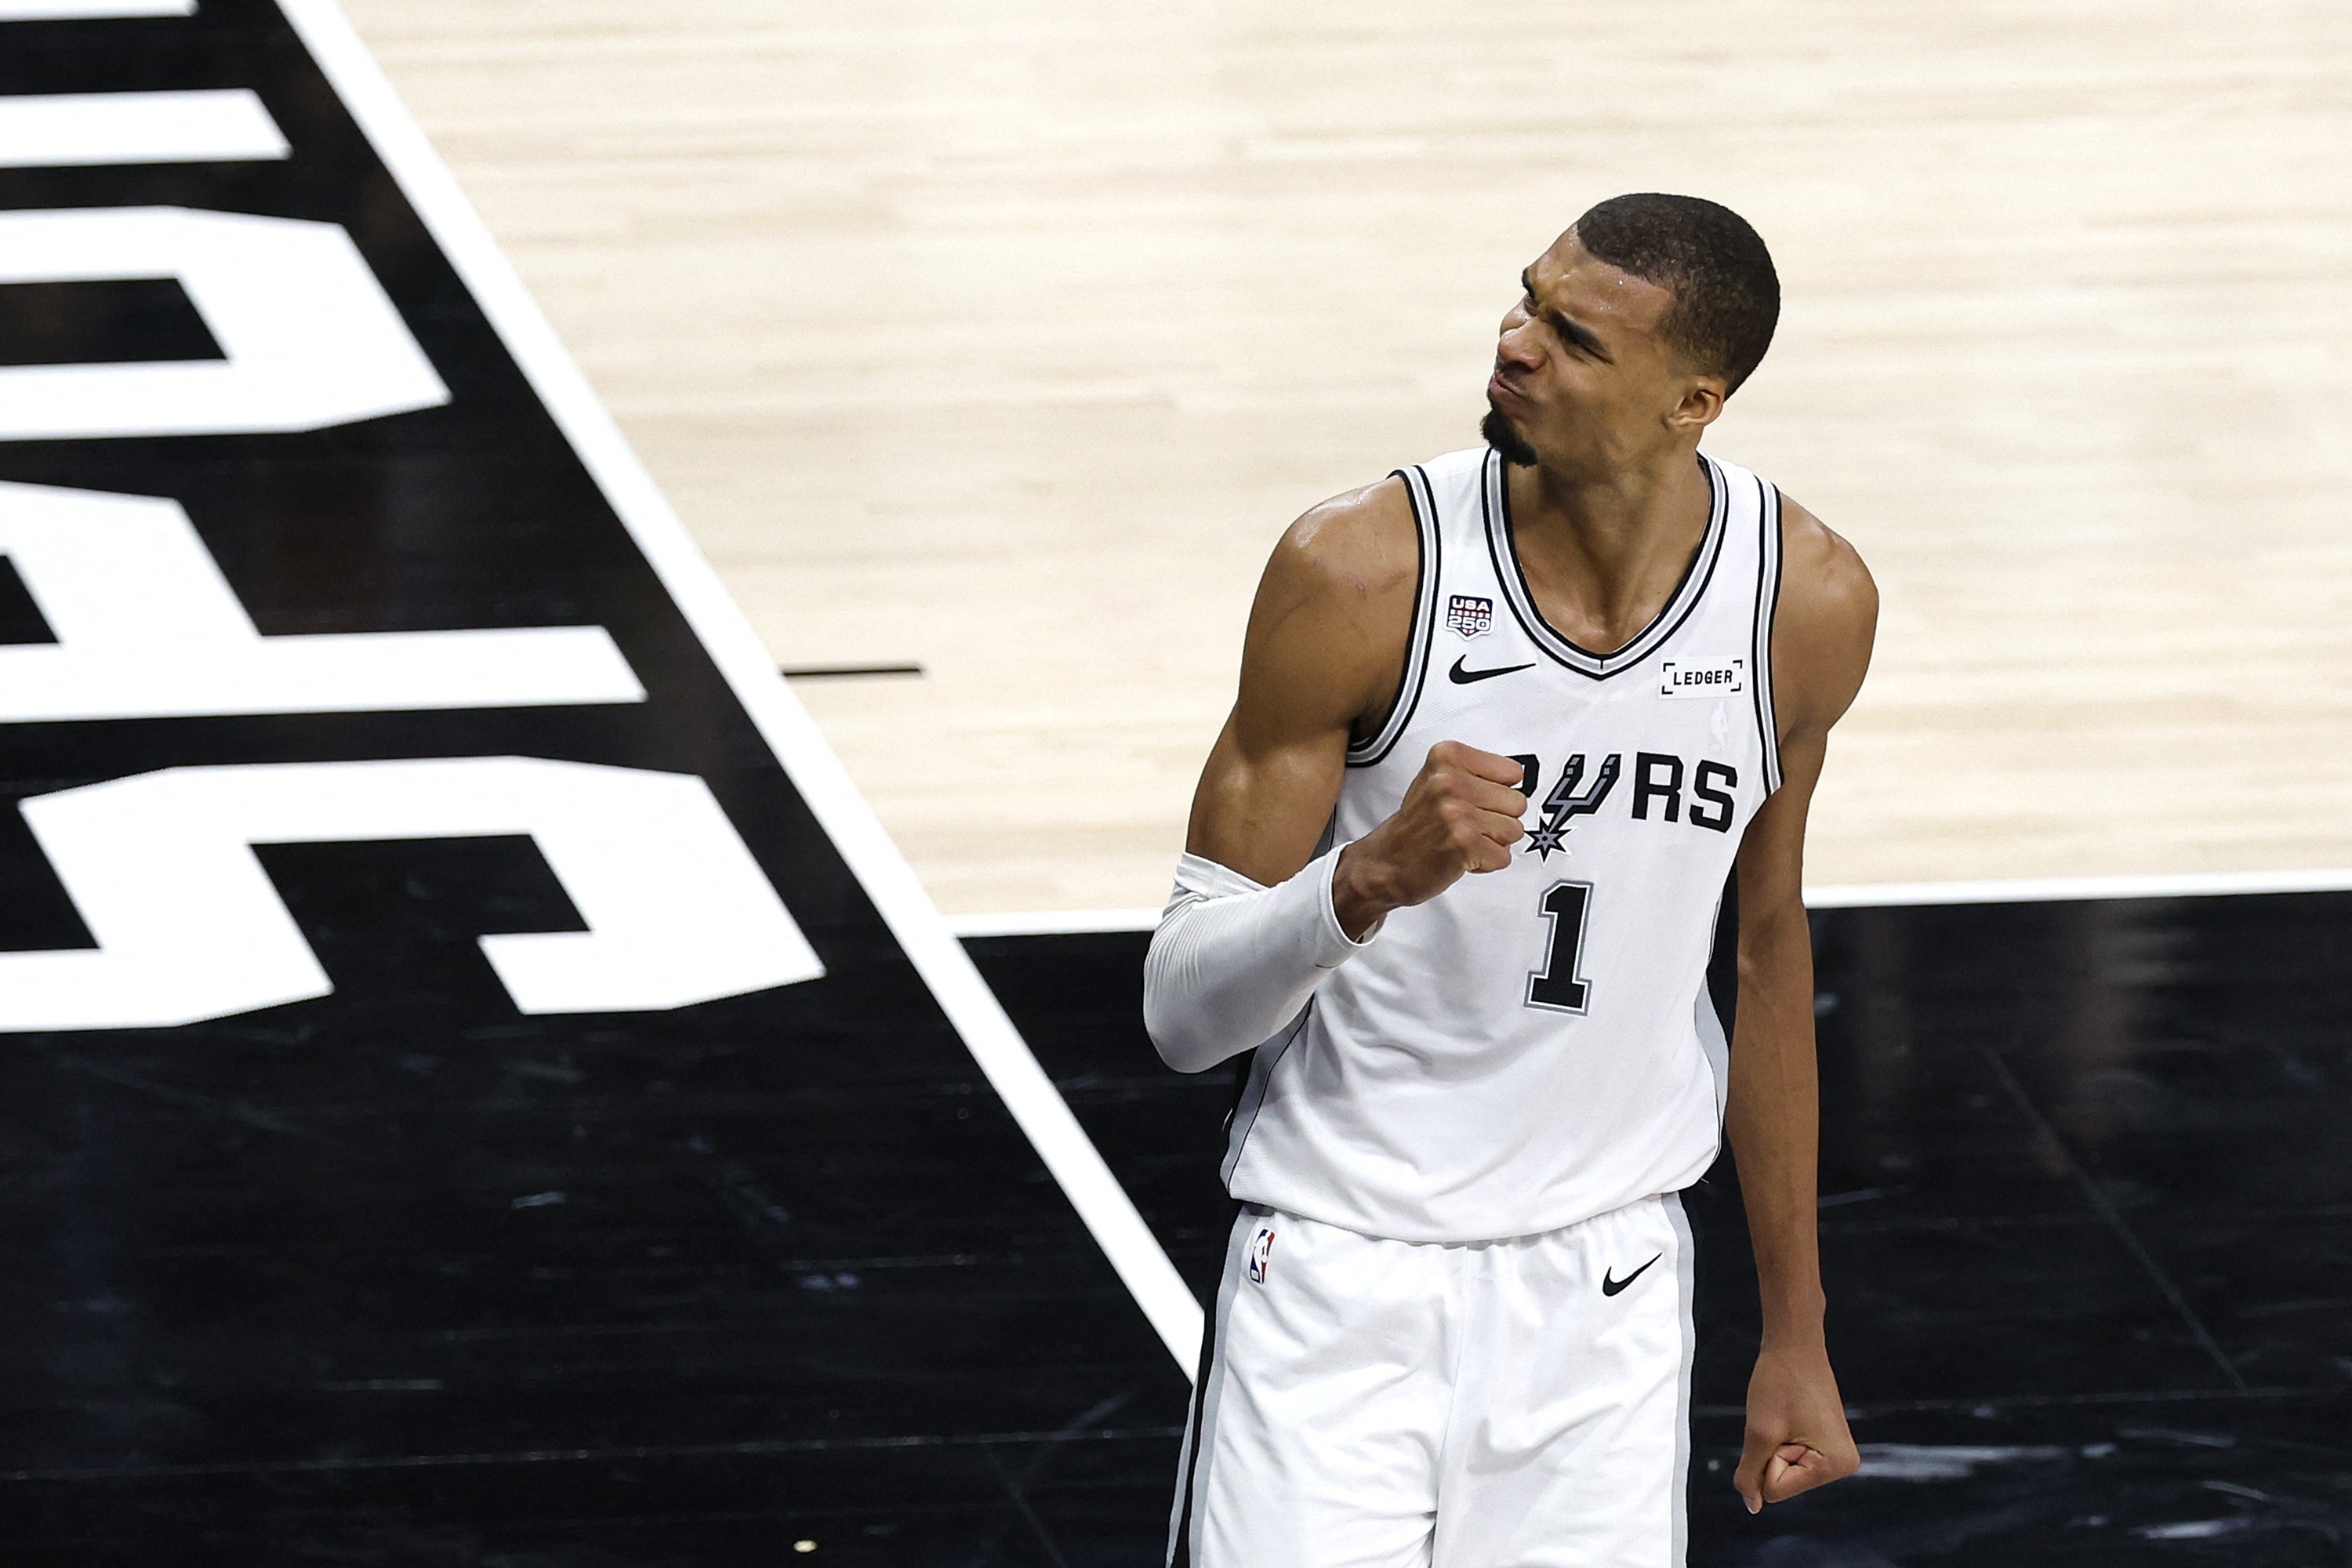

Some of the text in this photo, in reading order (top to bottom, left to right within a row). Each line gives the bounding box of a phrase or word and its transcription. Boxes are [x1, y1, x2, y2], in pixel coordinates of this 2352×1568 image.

[1452, 597, 1490, 612] USA
[1448, 615, 1490, 631] 250
[1673, 670, 1733, 686] LEDGER
[1523, 878, 1595, 1017] 1
